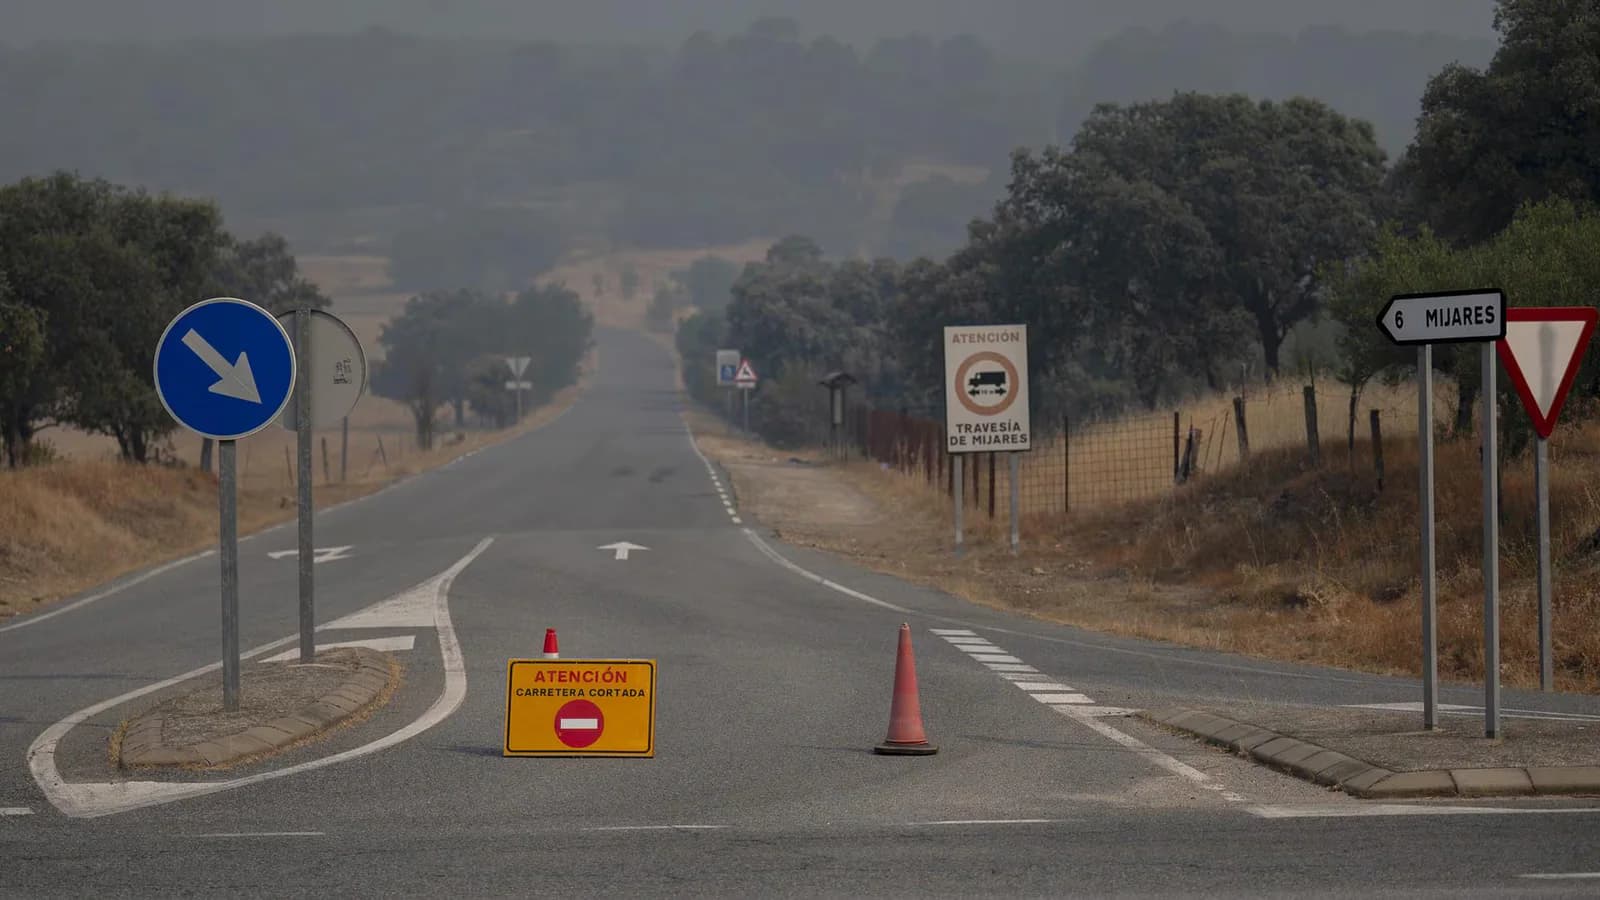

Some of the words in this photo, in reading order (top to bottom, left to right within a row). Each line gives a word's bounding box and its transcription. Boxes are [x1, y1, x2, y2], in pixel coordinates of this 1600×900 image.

[1395, 311, 1404, 329] 6
[1426, 305, 1495, 328] MIJARES
[952, 329, 1020, 344] ATENCIÓN
[956, 419, 1021, 433] TRAVESÍA
[949, 436, 967, 446] DE
[972, 433, 1028, 445] MIJARES
[534, 666, 627, 683] ATENCIÓN
[515, 688, 585, 697] CARRETERA
[589, 688, 645, 697] CORTADA
